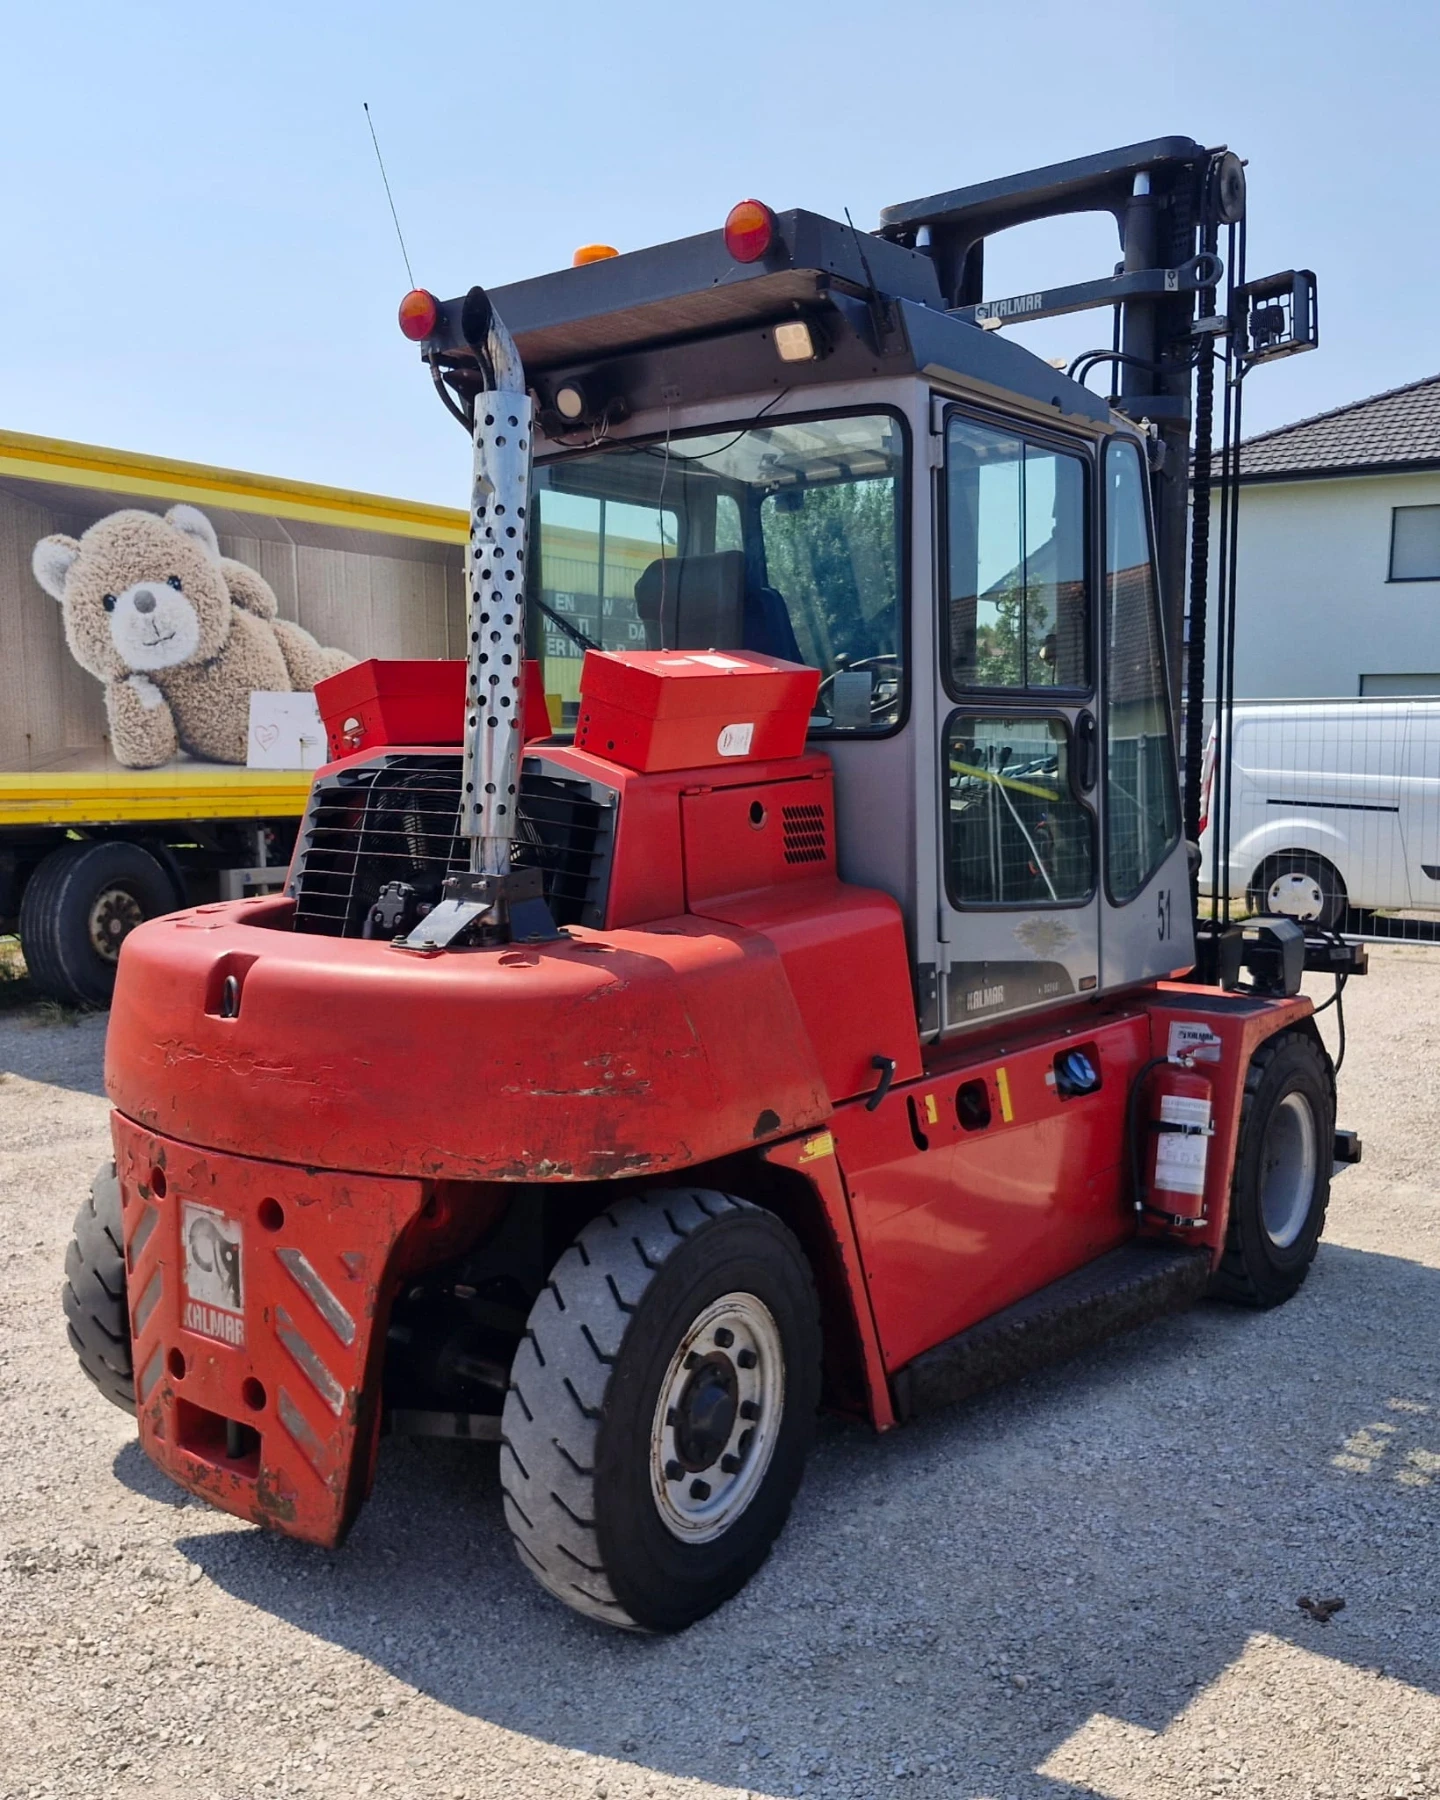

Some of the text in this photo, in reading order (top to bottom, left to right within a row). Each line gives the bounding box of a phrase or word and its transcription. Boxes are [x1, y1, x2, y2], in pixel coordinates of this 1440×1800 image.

[991, 294, 1042, 318] KALMAR
[1158, 889, 1171, 941] 51
[966, 985, 1004, 1011] KALMAR
[183, 1302, 245, 1346] KALMAR
